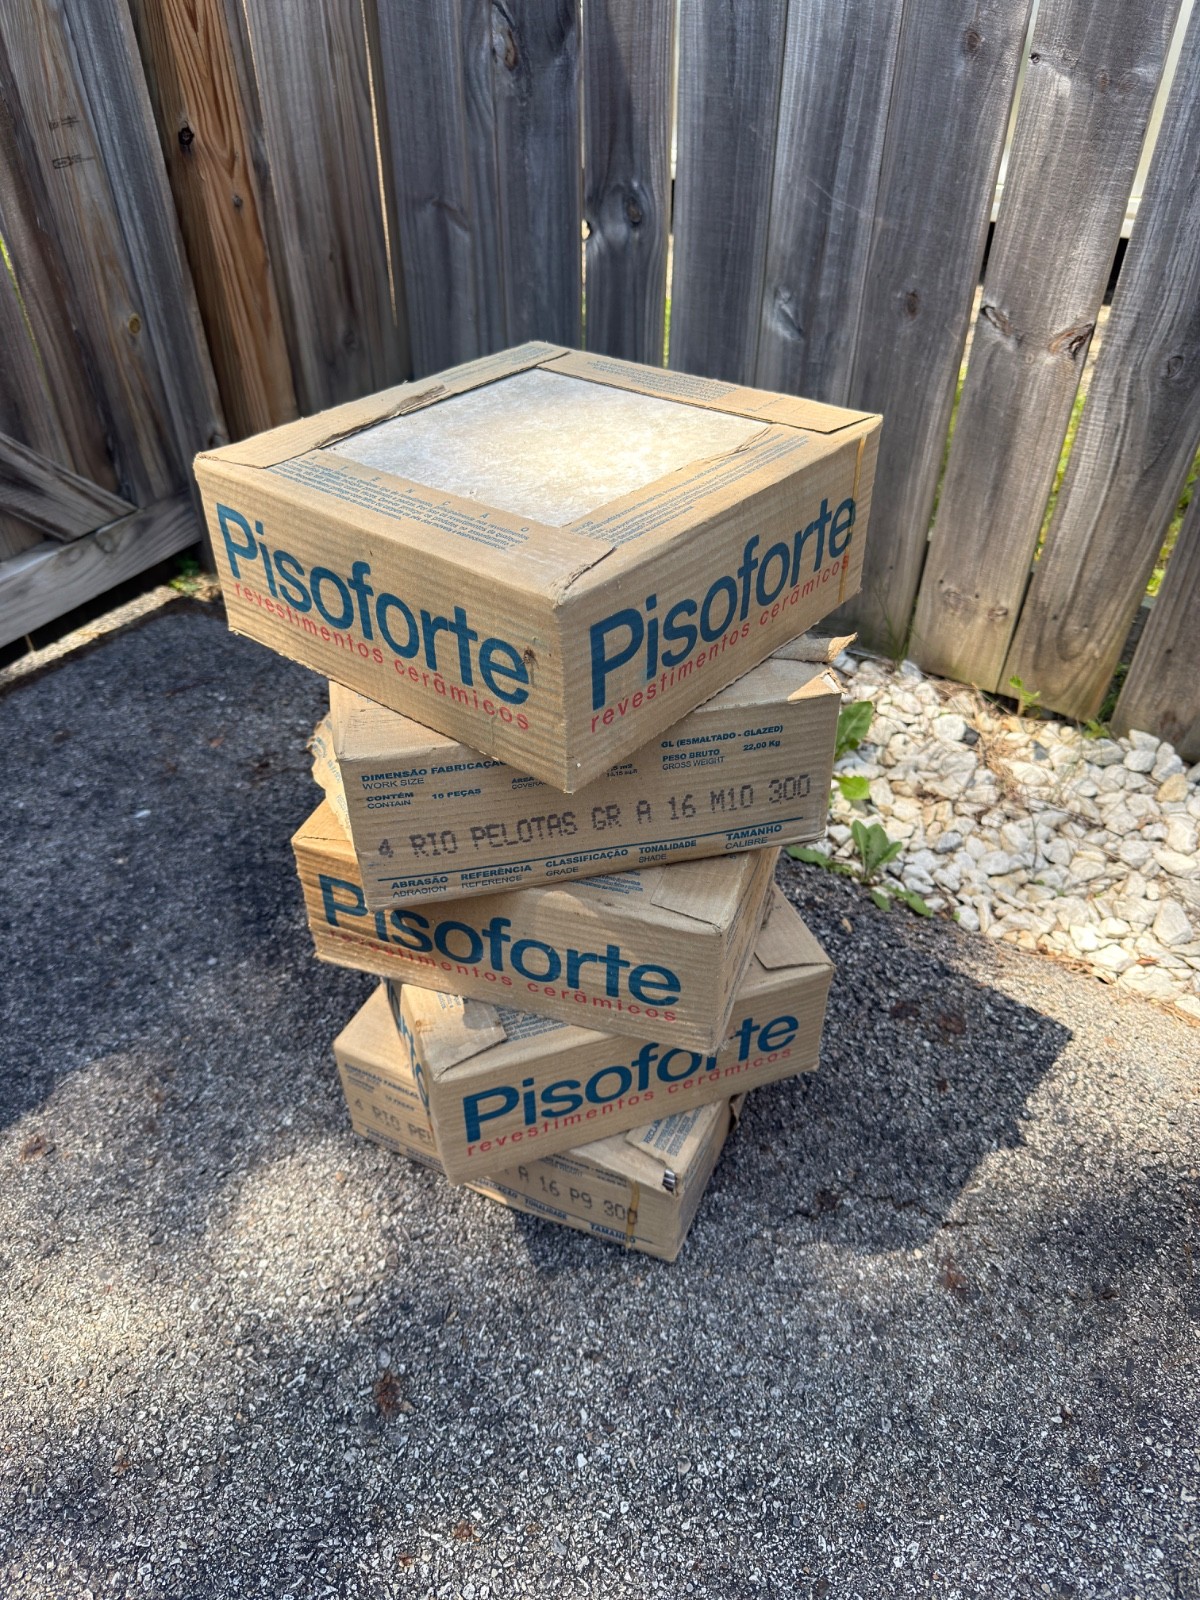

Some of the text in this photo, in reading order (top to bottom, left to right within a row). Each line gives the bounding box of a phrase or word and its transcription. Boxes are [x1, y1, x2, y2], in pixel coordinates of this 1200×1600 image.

[216, 502, 530, 705] Pisoforte
[234, 582, 384, 664] revestimentos
[589, 497, 857, 712] Pisoforte
[590, 622, 751, 733] revestimentos
[661, 740, 675, 749] GL
[676, 731, 737, 748] (ESMALTADO
[743, 724, 784, 738] GLAZED)
[662, 739, 781, 763] PESO BRUTO 22,00 Kg
[662, 755, 726, 771] GROSS WEIGHT
[361, 767, 428, 782] DIMENSÃO
[362, 777, 425, 790] WORK SIZE
[447, 788, 482, 799] PEÇAS
[367, 799, 412, 810] CONTAIN
[409, 830, 459, 858] RIO
[469, 811, 579, 850] PELOTAS
[591, 803, 622, 831] GR
[636, 799, 652, 825] A
[668, 793, 697, 821] 16
[710, 784, 754, 814] M10
[768, 774, 812, 805] 300
[391, 824, 783, 890] ABRASÃO REFERÊNCIA CLASSIFICAÇÃO TONALIDADE TAMANHO
[461, 874, 523, 889] REFERENCE
[545, 866, 579, 877] GRADE
[638, 854, 667, 864] SHADE
[725, 836, 768, 850] CALIBRE
[318, 873, 682, 1007] Pisoforte
[329, 929, 513, 987] revestimentos
[467, 1090, 655, 1157] revestimentos
[539, 1176, 560, 1197] 16
